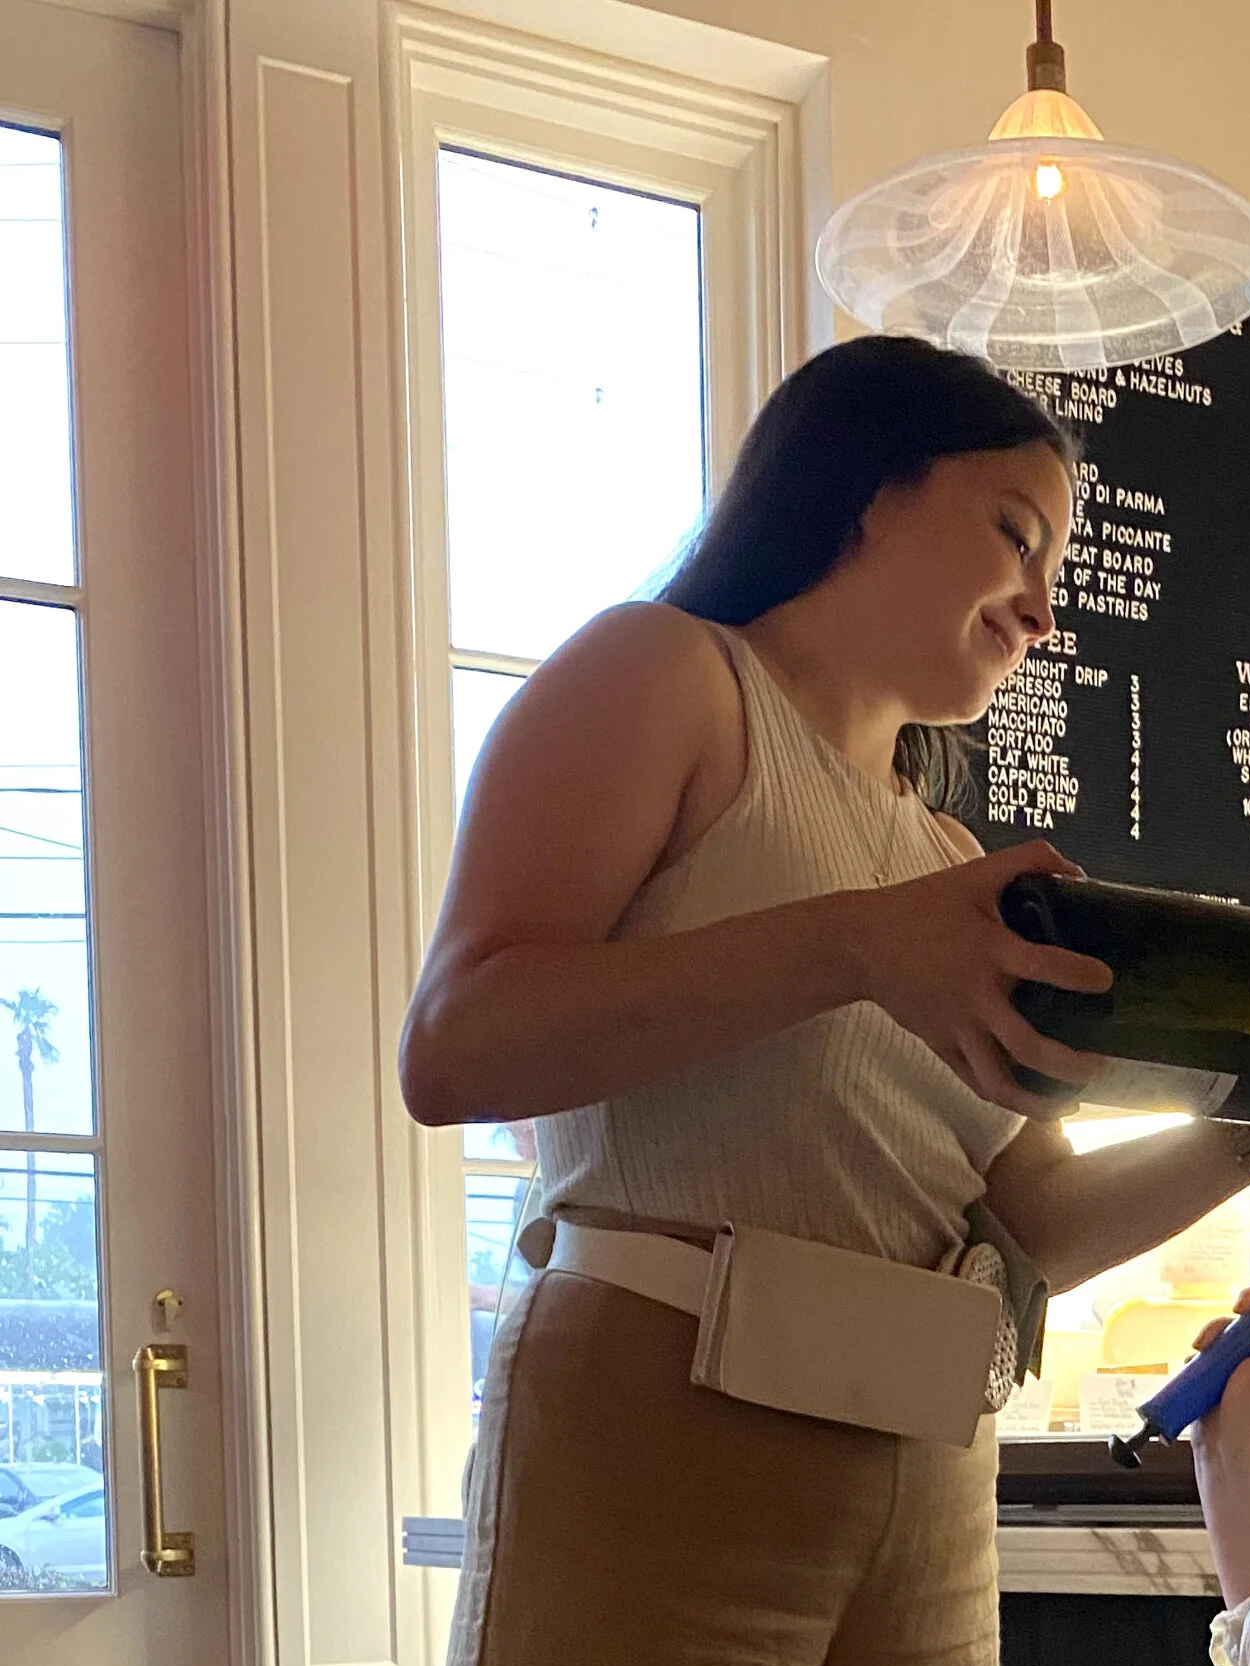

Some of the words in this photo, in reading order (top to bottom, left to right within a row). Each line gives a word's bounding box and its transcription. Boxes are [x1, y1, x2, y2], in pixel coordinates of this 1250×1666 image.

[1133, 356, 1184, 378] LIVES
[1071, 382, 1117, 408] BOARD
[1115, 369, 1127, 387] &
[1131, 371, 1212, 406] HAZELNUTS
[1056, 398, 1103, 424] LINING
[1096, 484, 1110, 504] DI
[1116, 488, 1165, 515] PARMA
[1102, 521, 1171, 553] PICCANTE
[1103, 549, 1154, 576] BOARD
[1073, 567, 1092, 586] OF
[1097, 571, 1127, 594] THE
[1134, 578, 1161, 600] DAY
[1078, 591, 1149, 621] PASTRIES
[1017, 658, 1068, 681] DNIGHT
[1075, 665, 1108, 687] DRIP
[1130, 674, 1140, 692] 3
[998, 674, 1062, 699] SPRESSO
[988, 690, 1068, 719] AMERICANO
[1130, 693, 1140, 711] 3
[988, 708, 1066, 737] MACCHIATO
[1131, 712, 1141, 730] 3
[988, 727, 1053, 753] CORTADO
[1131, 730, 1141, 748] 3
[1226, 728, 1250, 747] (OR
[988, 746, 1022, 767] FLAT
[1027, 752, 1070, 775] WHITE
[1130, 749, 1140, 767] 4
[988, 766, 1079, 795] CAPPUCCINO
[1130, 768, 1140, 785] 4
[988, 785, 1028, 806] COLD
[1037, 791, 1077, 814] BREW
[1130, 786, 1140, 804] 4
[988, 803, 1017, 824] HOT
[1024, 807, 1054, 830] TEA
[1130, 804, 1140, 822] 4
[1130, 823, 1140, 840] 4
